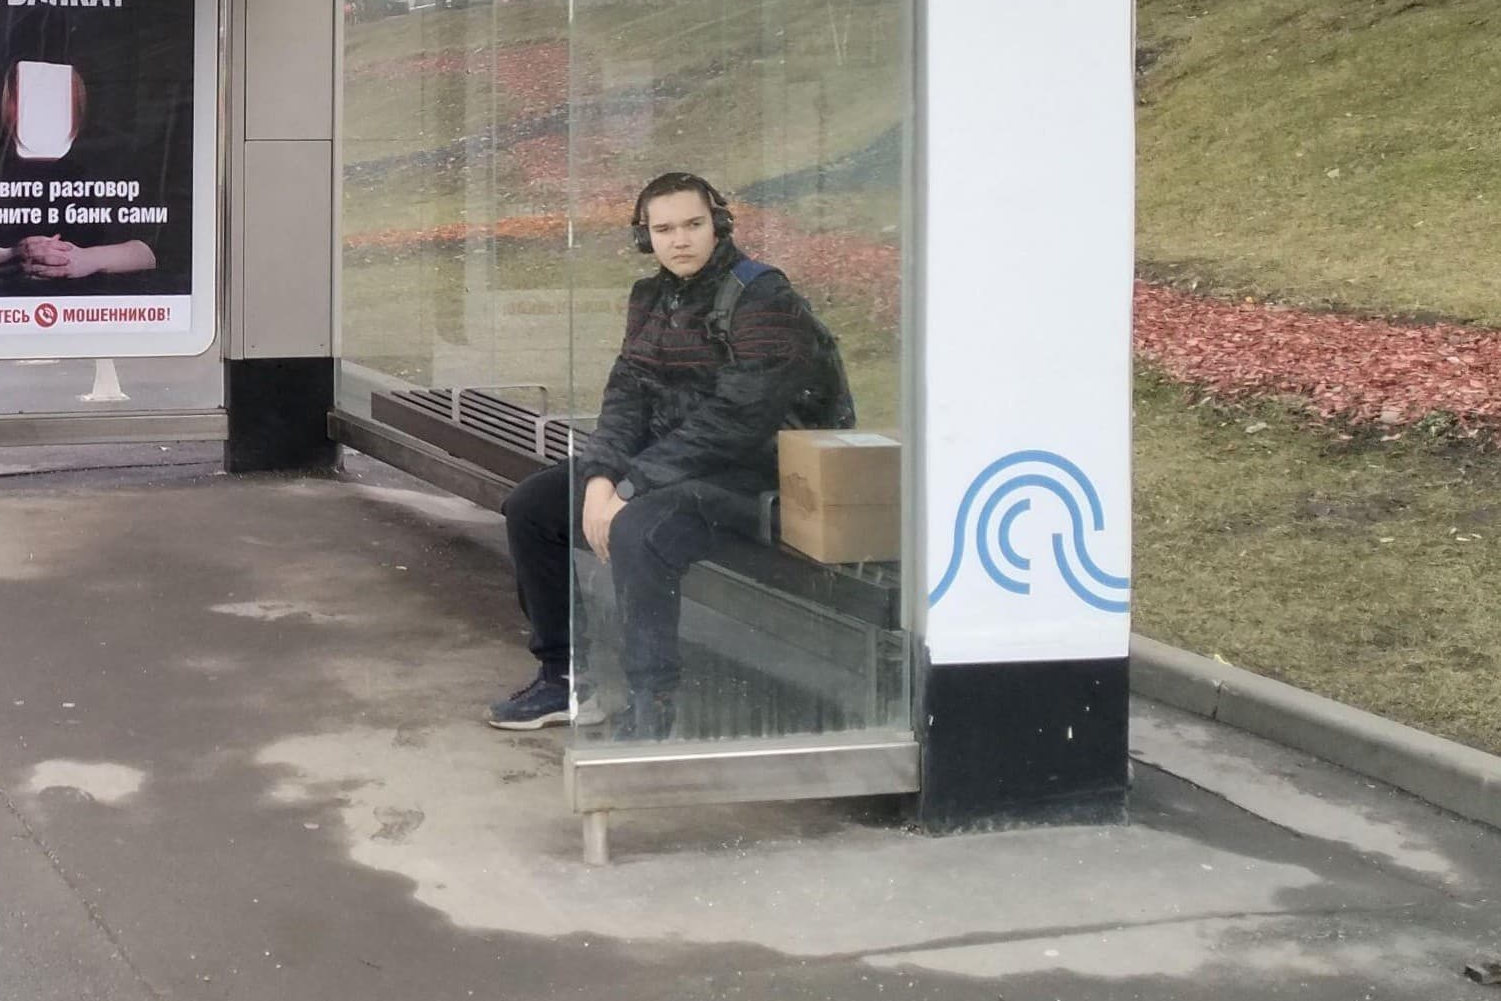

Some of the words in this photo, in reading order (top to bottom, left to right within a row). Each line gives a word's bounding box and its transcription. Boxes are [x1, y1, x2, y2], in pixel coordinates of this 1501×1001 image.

[49, 180, 140, 202] разговор
[48, 208, 60, 225] в
[65, 203, 112, 224] банк
[117, 207, 168, 224] сами
[63, 307, 171, 323] МОШЕННИКОВ!
